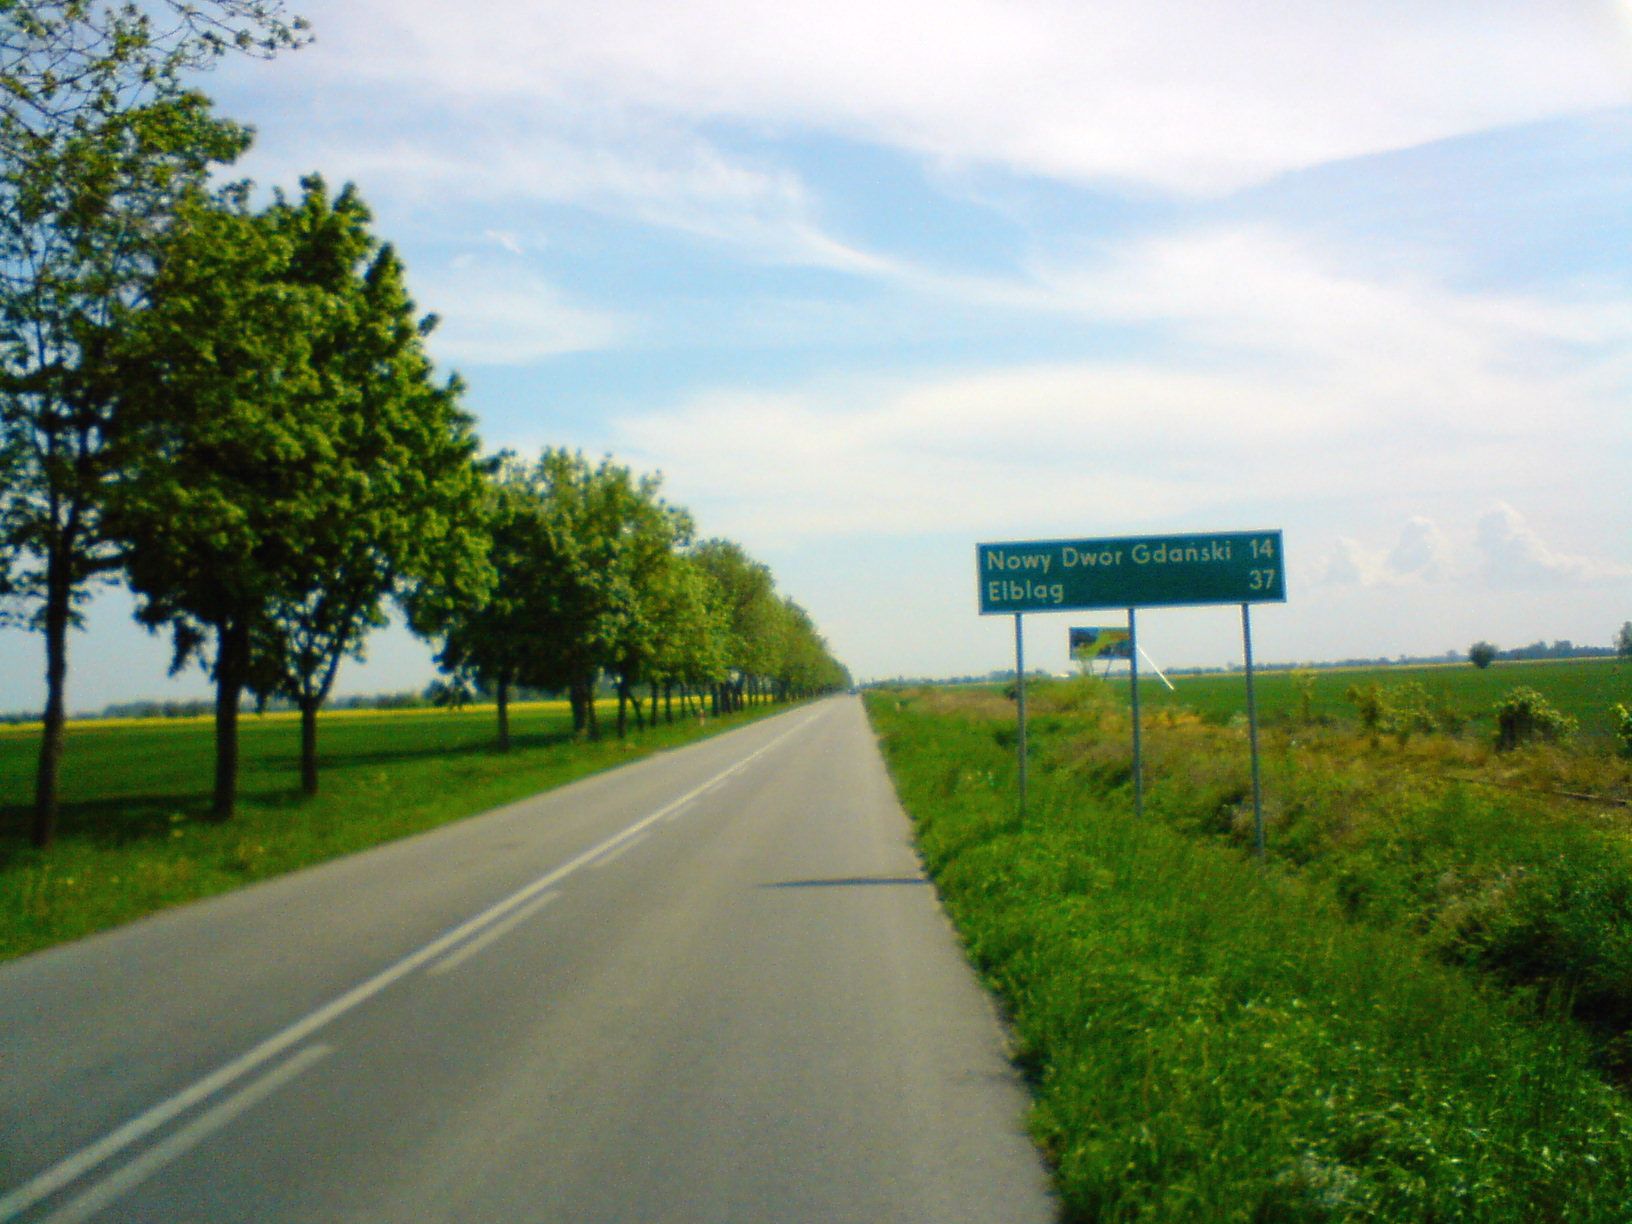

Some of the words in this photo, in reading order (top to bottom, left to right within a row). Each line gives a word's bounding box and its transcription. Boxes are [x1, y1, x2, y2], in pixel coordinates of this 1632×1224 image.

[987, 551, 1051, 574] Nowy
[1131, 541, 1232, 565] Gdański
[1249, 539, 1275, 559] 14
[1249, 569, 1276, 590] 37
